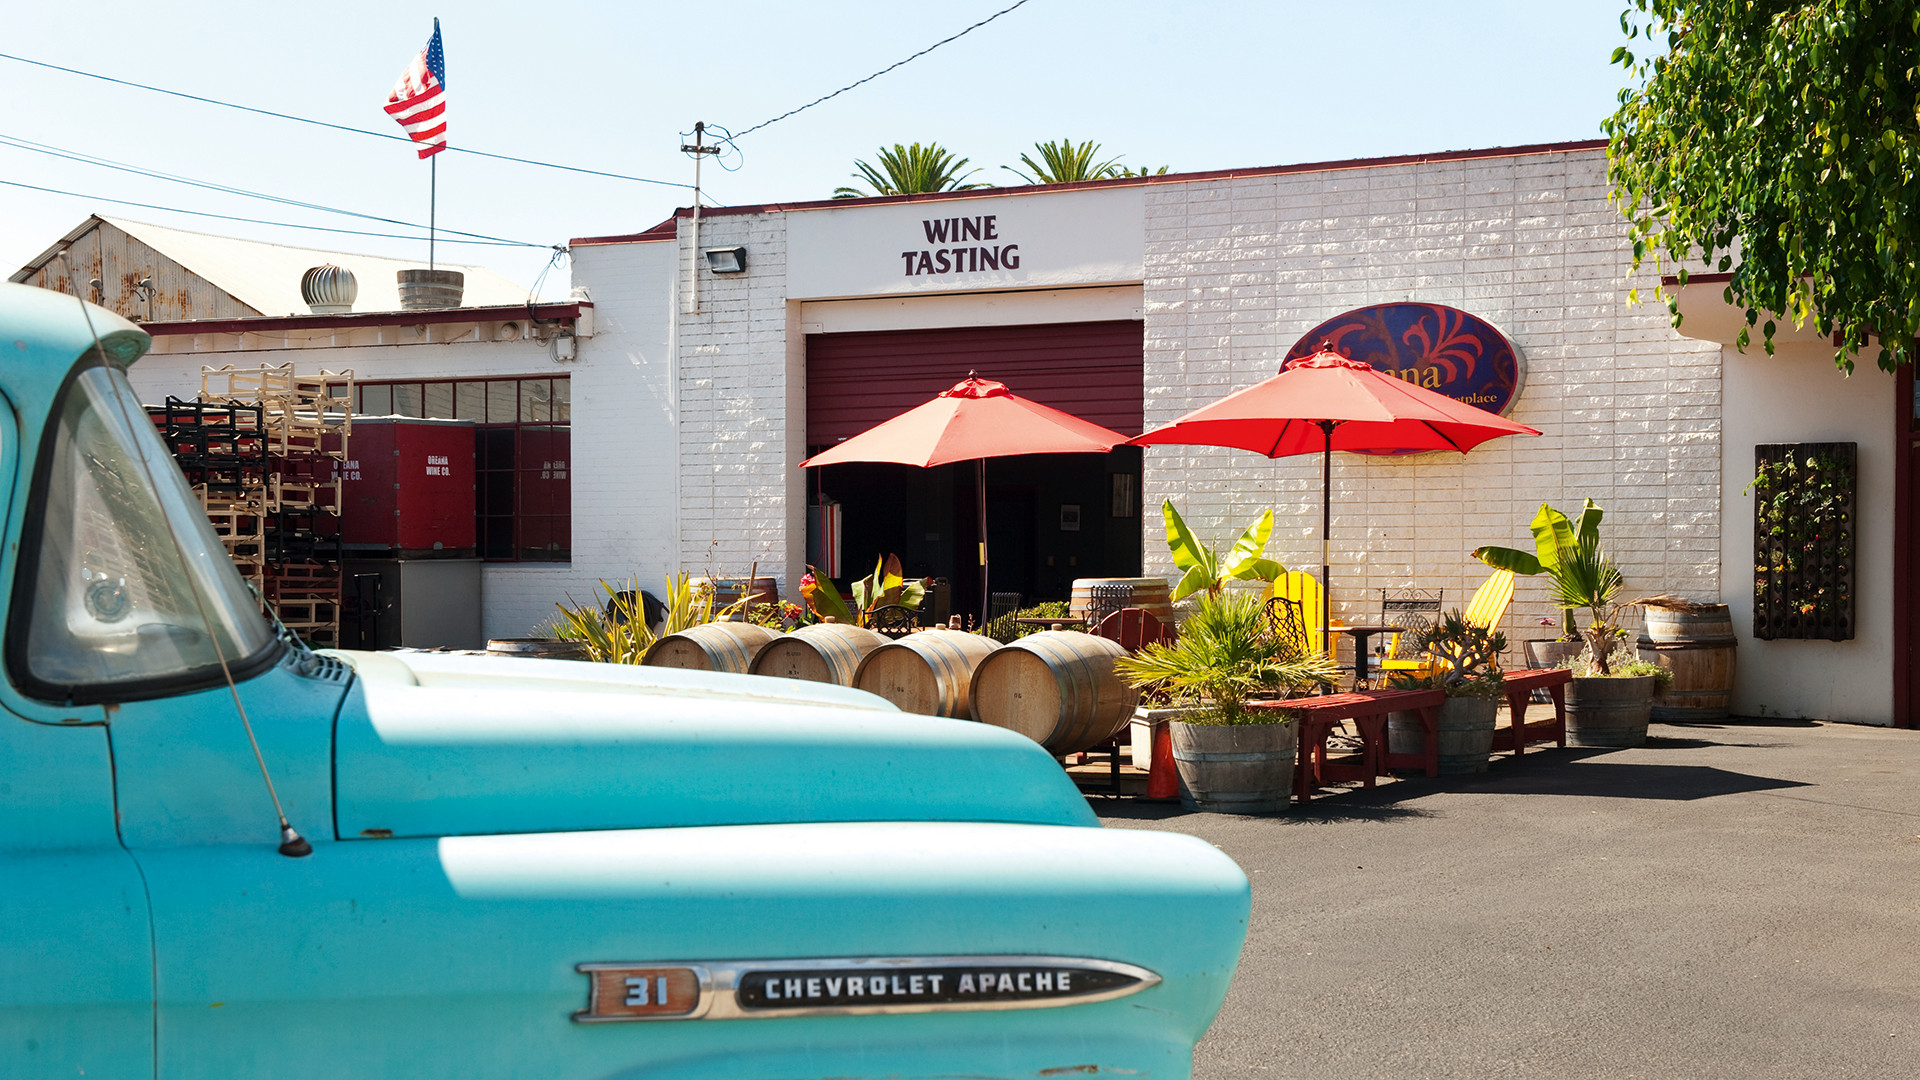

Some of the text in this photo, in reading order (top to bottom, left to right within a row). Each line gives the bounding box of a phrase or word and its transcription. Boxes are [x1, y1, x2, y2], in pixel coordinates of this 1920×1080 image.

[923, 215, 998, 244] WINE
[902, 244, 1020, 276] TASTING
[333, 460, 360, 470] OEANA
[427, 455, 449, 465] OREANA
[331, 471, 362, 481] WE CO.
[425, 466, 451, 476] WINE CO.
[624, 976, 668, 1006] 31
[765, 972, 1071, 999] CHEVROLET APACHE
